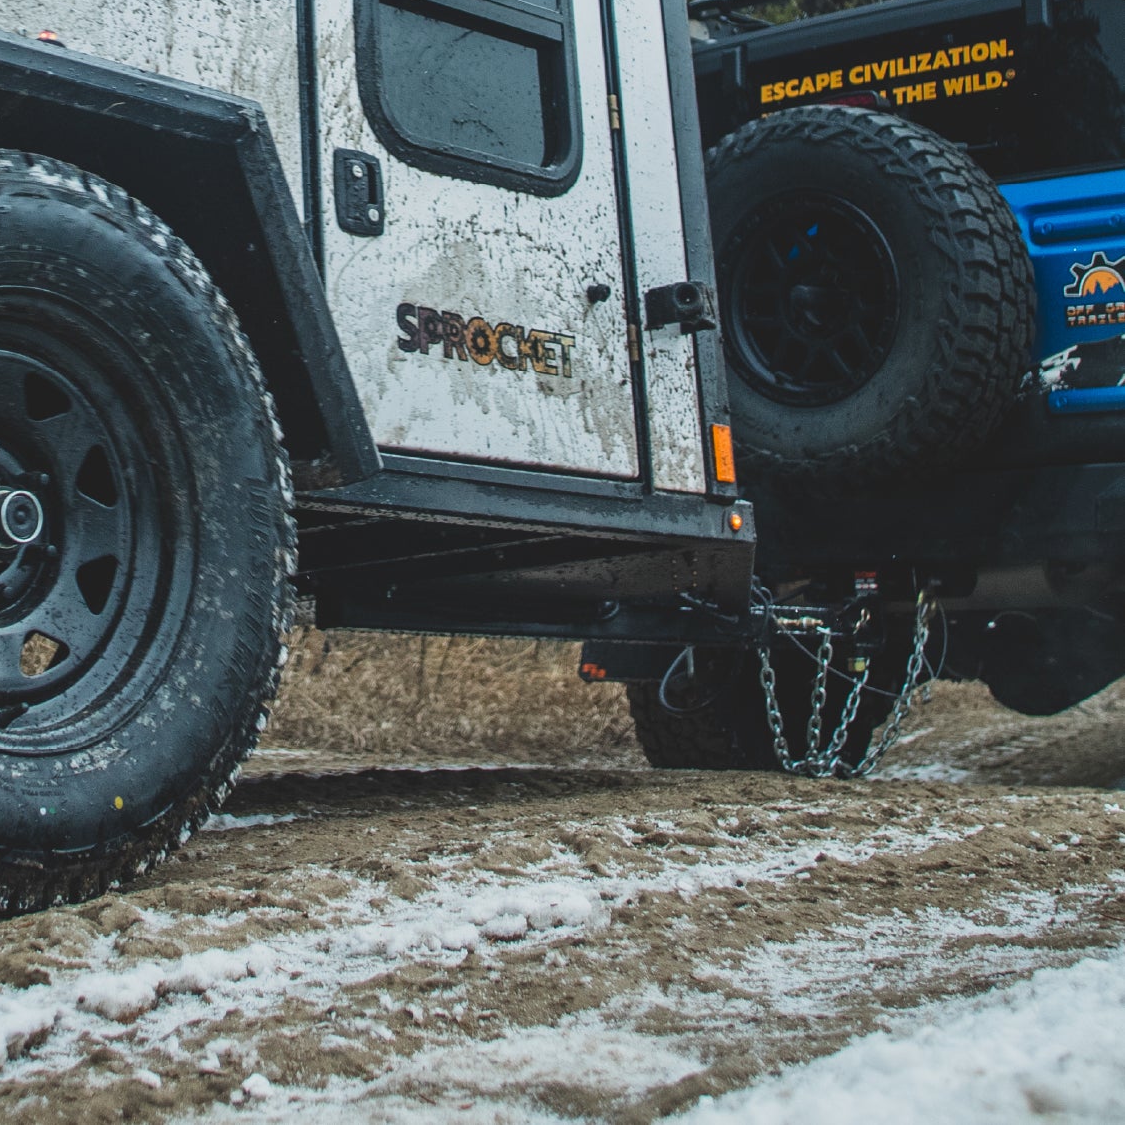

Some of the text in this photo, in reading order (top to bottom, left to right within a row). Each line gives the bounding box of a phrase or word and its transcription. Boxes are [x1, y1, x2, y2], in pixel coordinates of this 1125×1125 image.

[761, 39, 1014, 103] ESCAPE CIVILIZATION.
[893, 82, 937, 105] THE
[1067, 304, 1094, 316] OFF
[397, 303, 575, 378] SPROCKET
